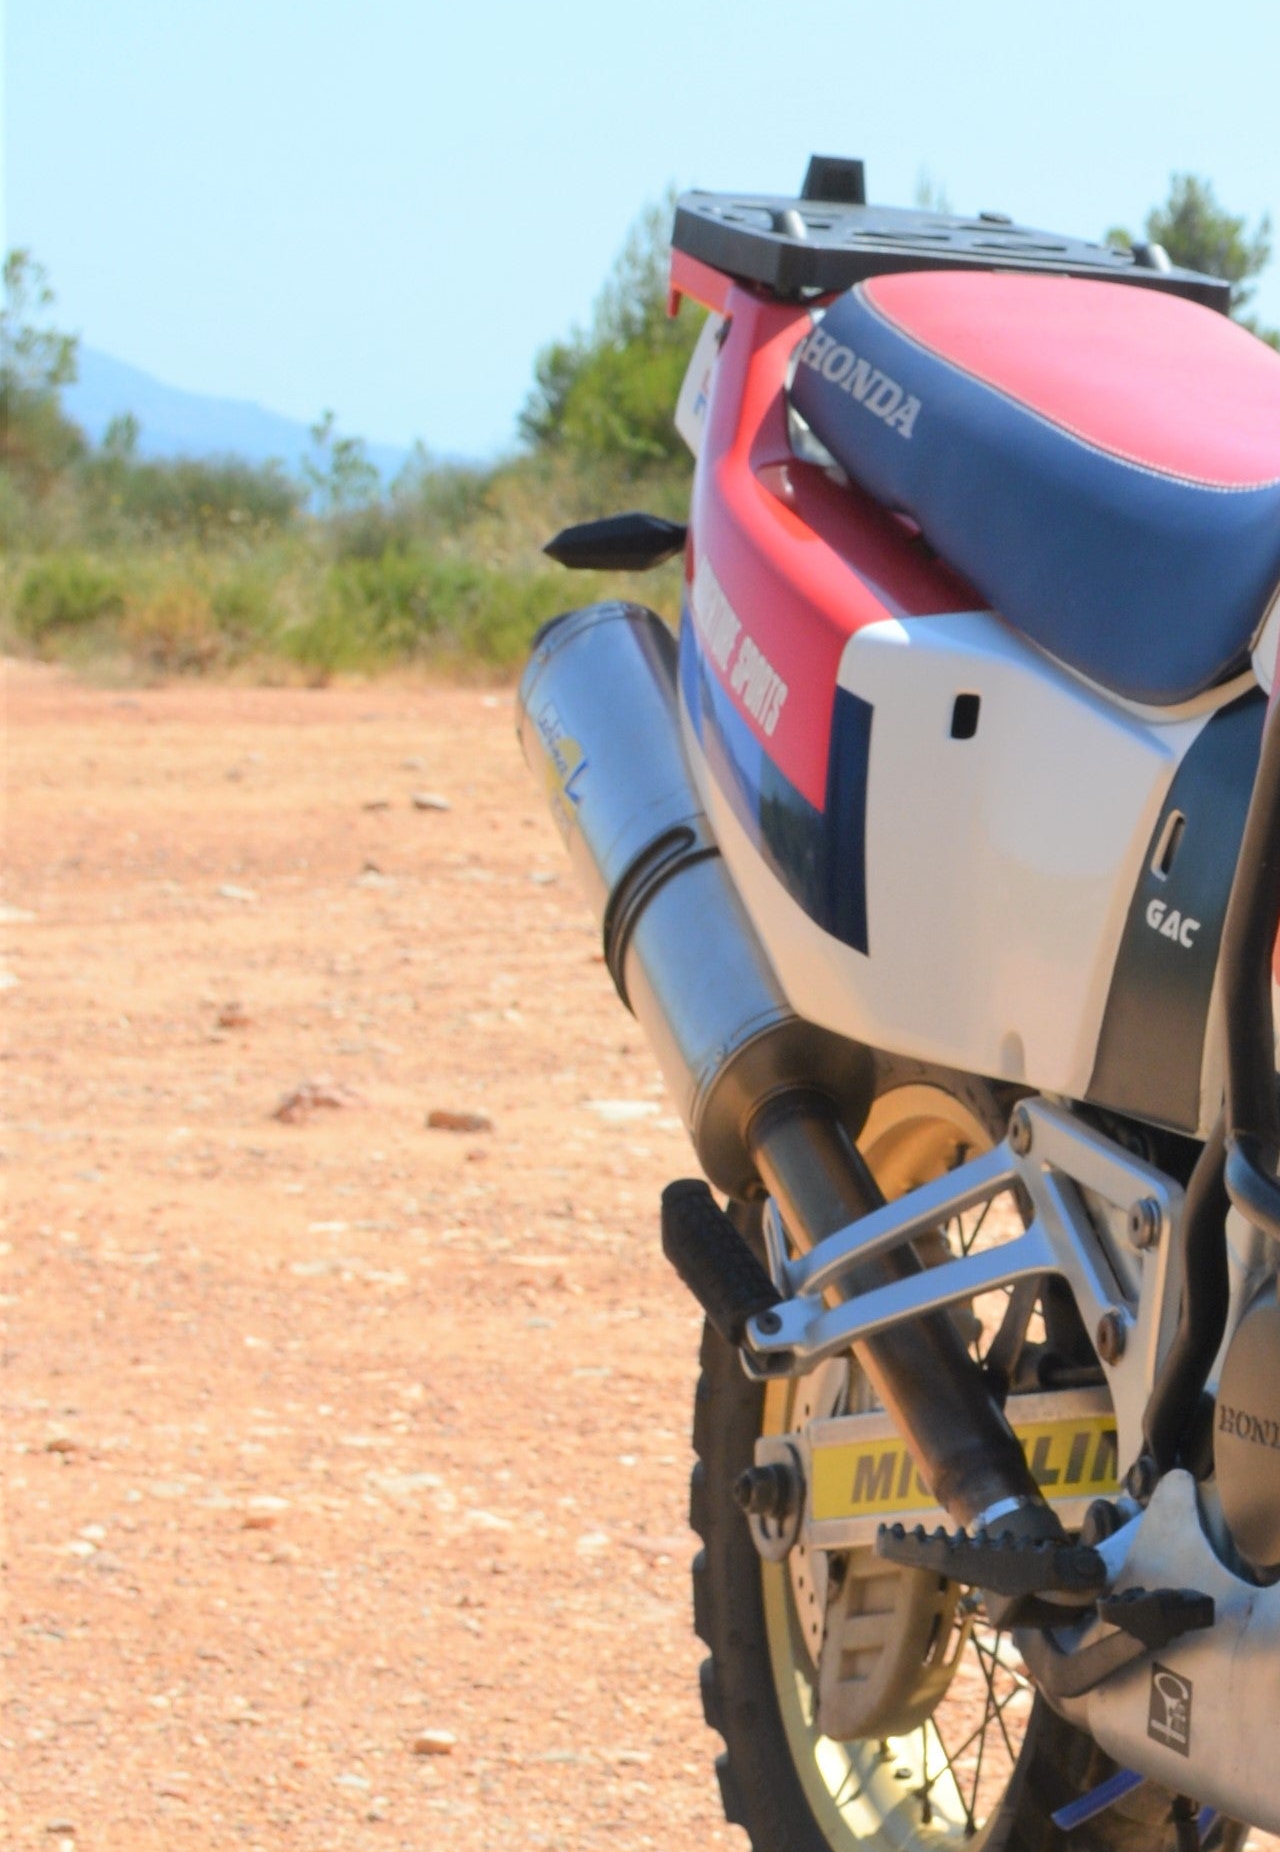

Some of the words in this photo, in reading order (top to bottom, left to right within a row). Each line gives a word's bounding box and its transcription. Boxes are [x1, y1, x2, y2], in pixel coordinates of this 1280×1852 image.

[799, 326, 922, 439] HONDA
[1146, 898, 1201, 949] GAC
[851, 1430, 1118, 1504] MILIN
